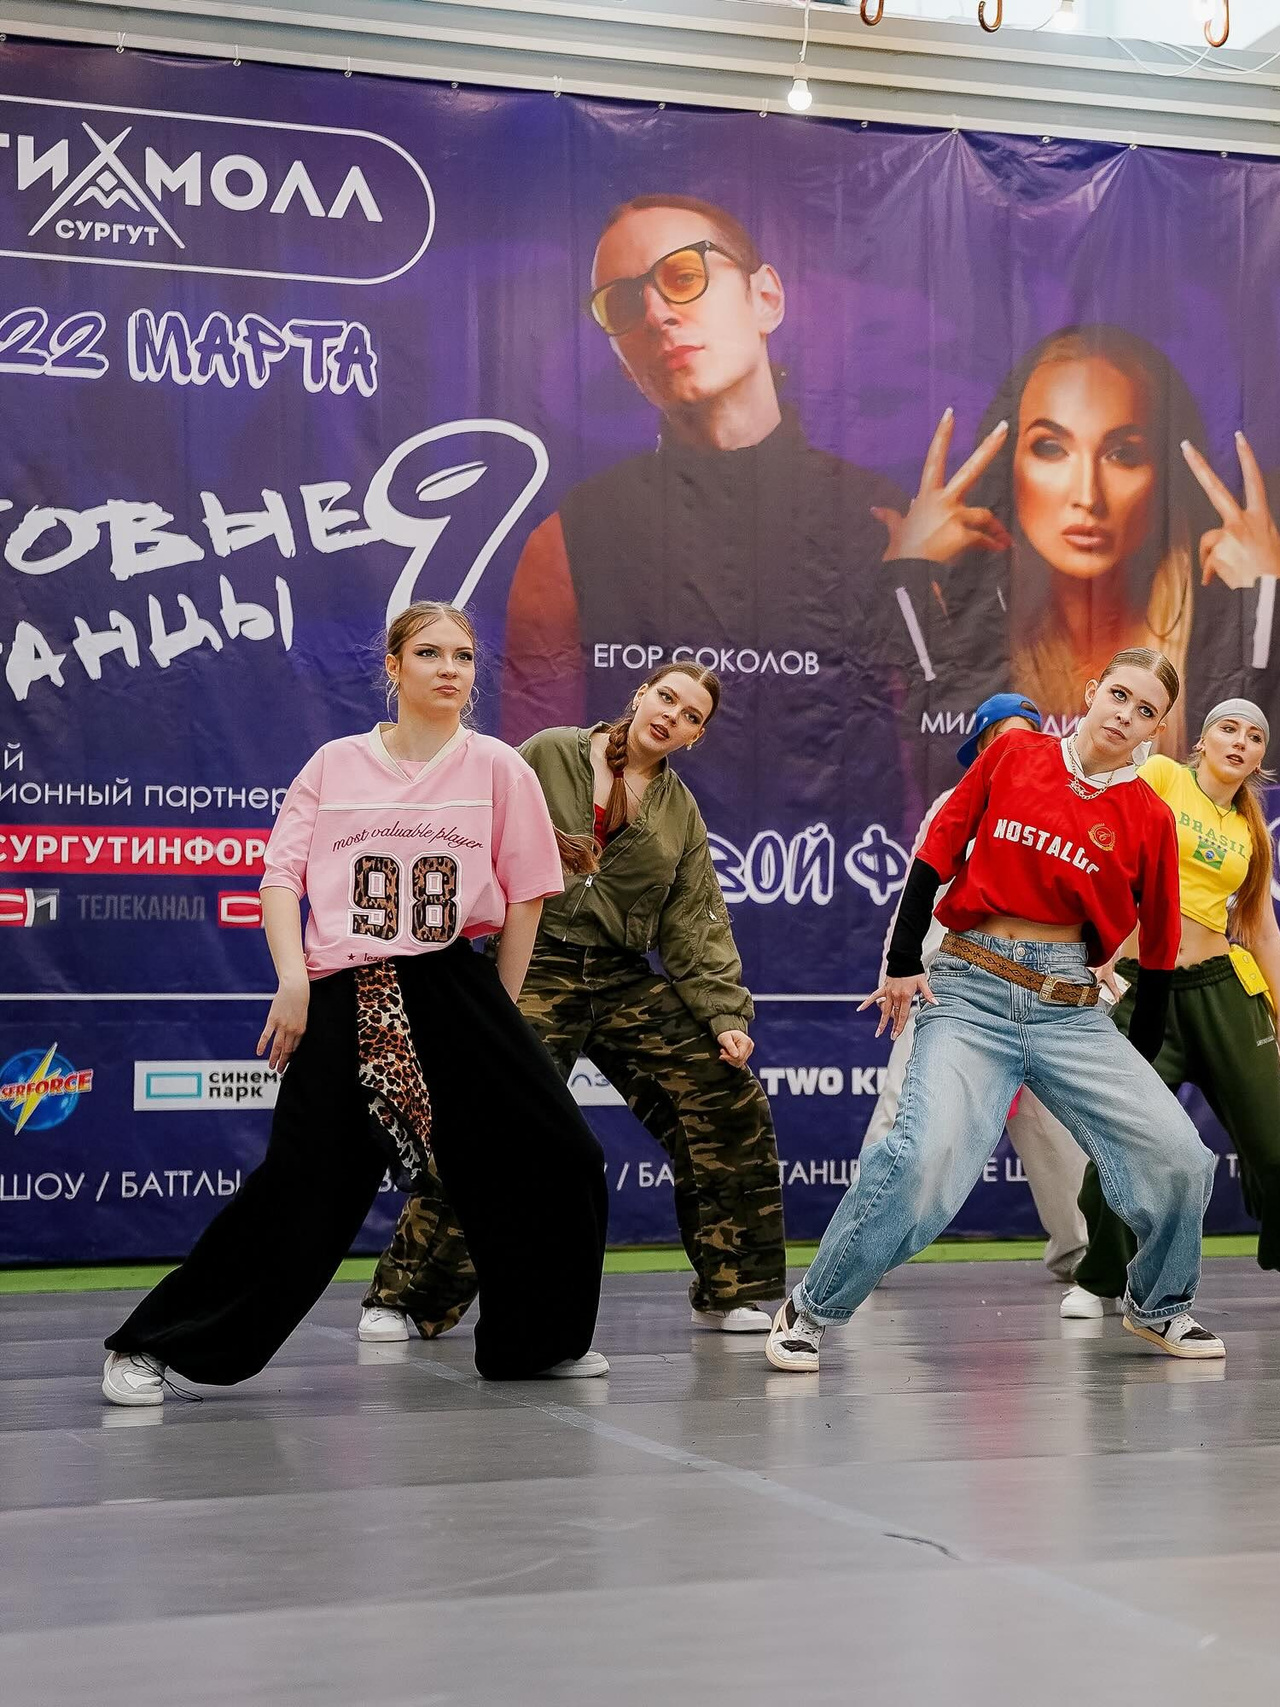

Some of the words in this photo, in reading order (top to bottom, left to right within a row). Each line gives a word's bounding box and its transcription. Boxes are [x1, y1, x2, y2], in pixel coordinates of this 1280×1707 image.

[145, 146, 383, 222] МОЛЛ
[55, 218, 159, 246] СУРГУТ
[0, 306, 109, 379] 22
[127, 308, 378, 398] МАРТА
[0, 481, 382, 580] ОВЫЕ
[0, 575, 293, 701] АНЦЫ
[594, 644, 661, 668] ЕГОР
[671, 646, 819, 675] СОКОЛОВ
[145, 782, 288, 815] партнер
[332, 829, 369, 852] most
[371, 821, 434, 838] valuable
[428, 827, 483, 849] player
[1179, 811, 1247, 859] BRASIL
[77, 894, 205, 922] ТЕЛЕКАНАЛ
[348, 851, 462, 945] 98
[209, 1070, 282, 1085] синем
[759, 1067, 844, 1096] TWO
[209, 1086, 263, 1102] парк
[0, 1173, 85, 1200] ШОУ
[121, 1169, 241, 1198] БАТТЛЫ
